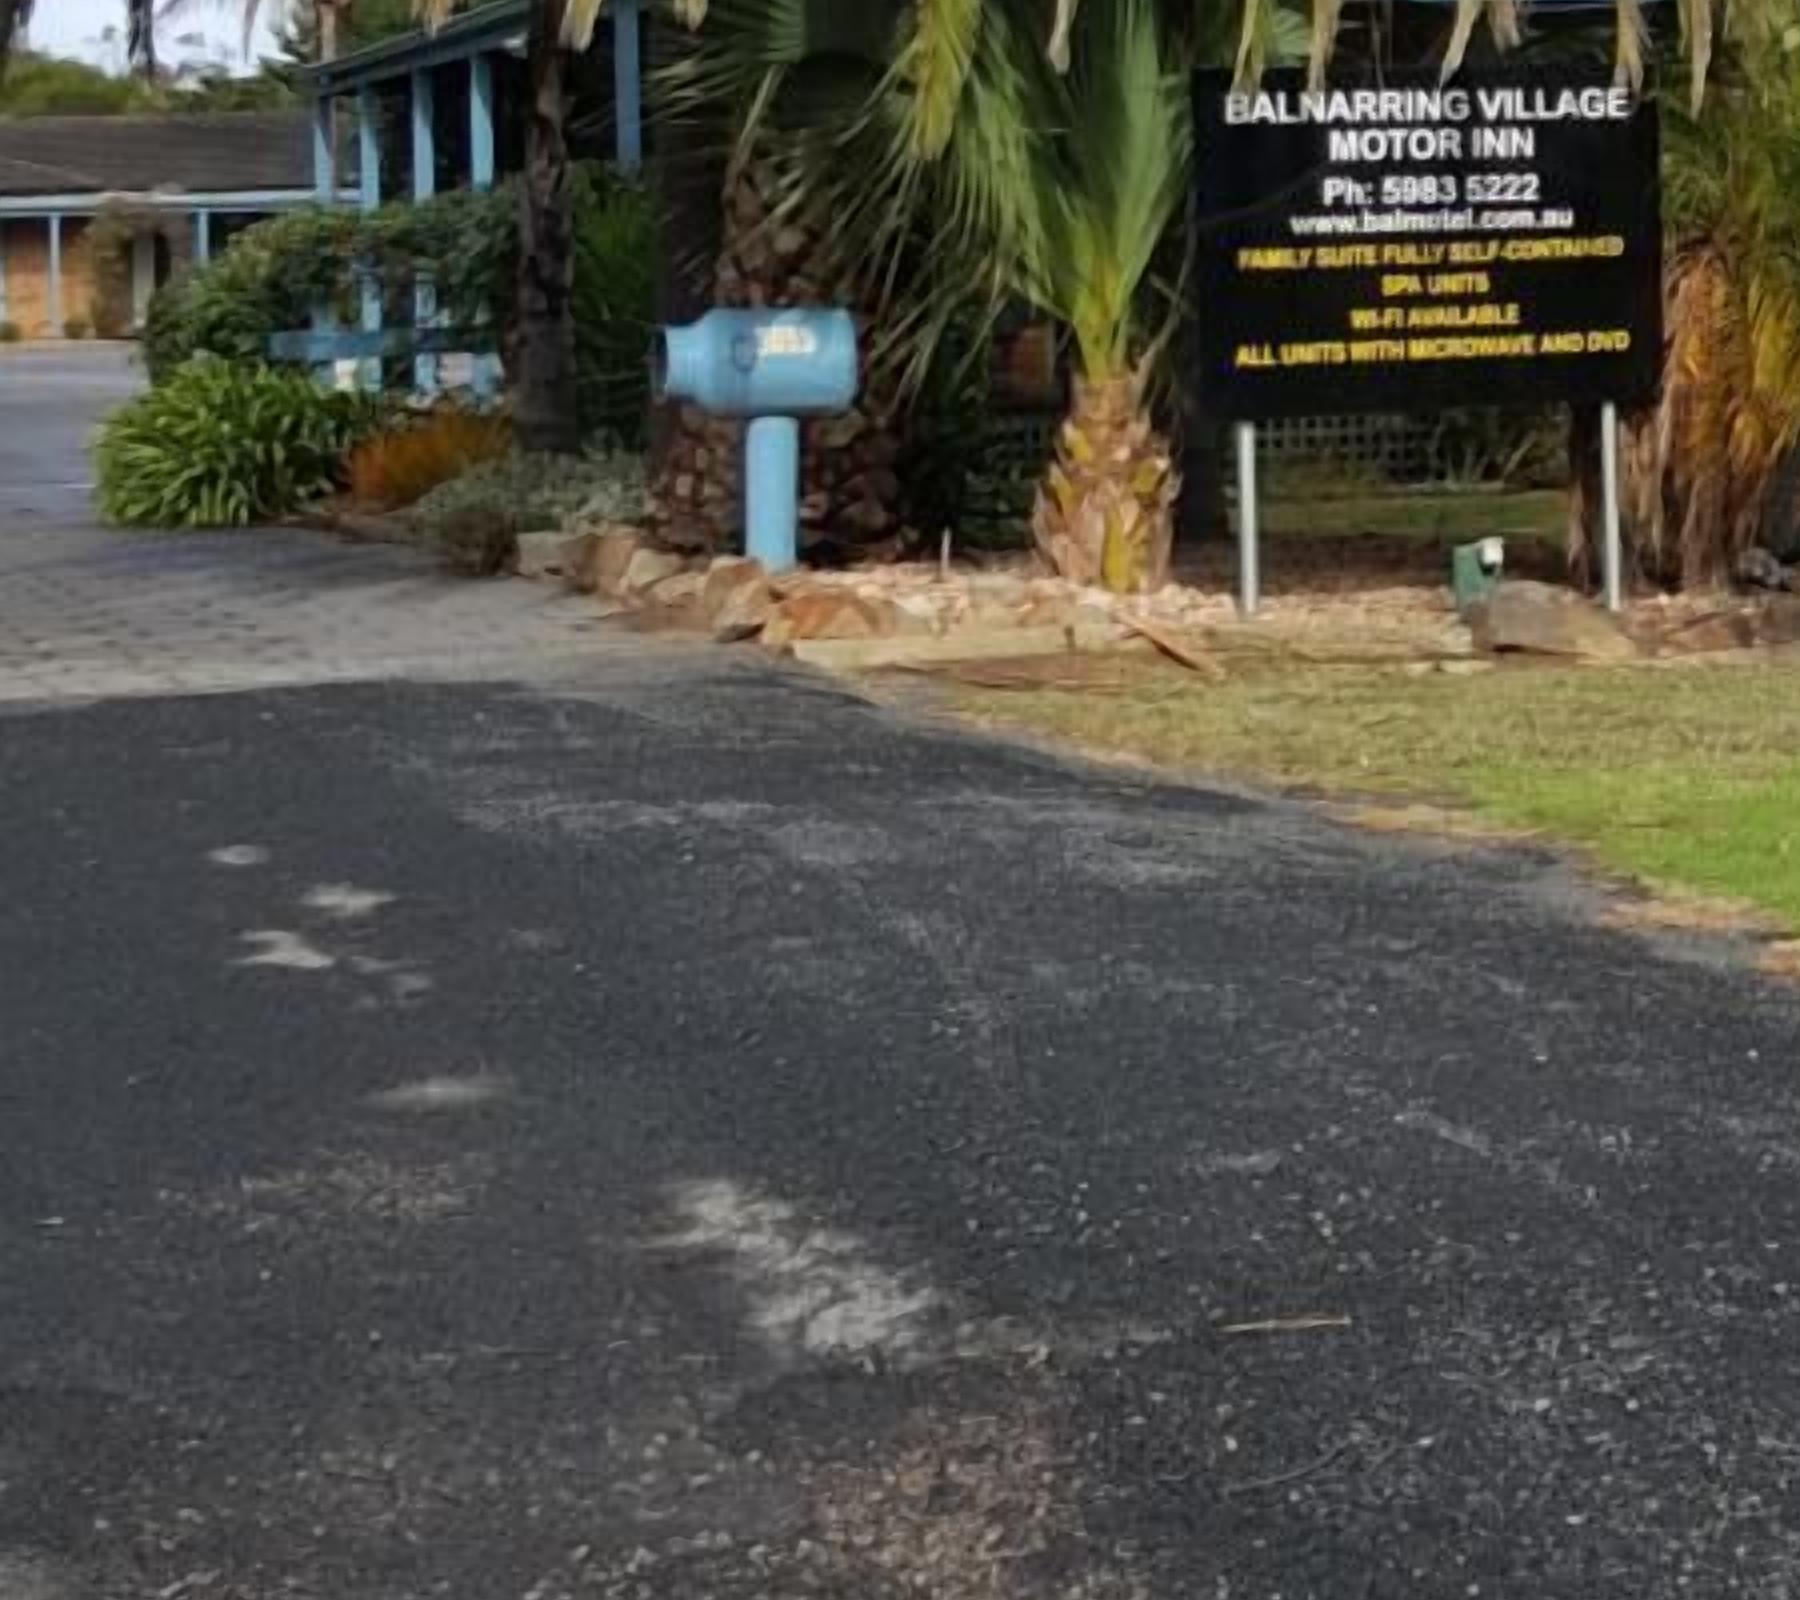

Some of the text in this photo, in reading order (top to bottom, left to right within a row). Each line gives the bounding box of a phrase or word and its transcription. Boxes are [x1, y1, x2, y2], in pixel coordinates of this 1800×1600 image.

[1225, 86, 1631, 124] BALNARRING VILLAGE
[1329, 127, 1535, 161] MOTOR INN
[1322, 177, 1374, 206] Ph:
[1466, 172, 1540, 202] 5222
[1237, 247, 1312, 270] FAMILY
[1316, 245, 1377, 267] SUITE
[1383, 242, 1445, 265] FULLY
[1408, 303, 1520, 327] AVAILABLE
[1235, 343, 1275, 368] ALL
[1280, 340, 1346, 364] UNITS
[1407, 333, 1535, 360] MICROWAVE
[1540, 332, 1584, 354] AND
